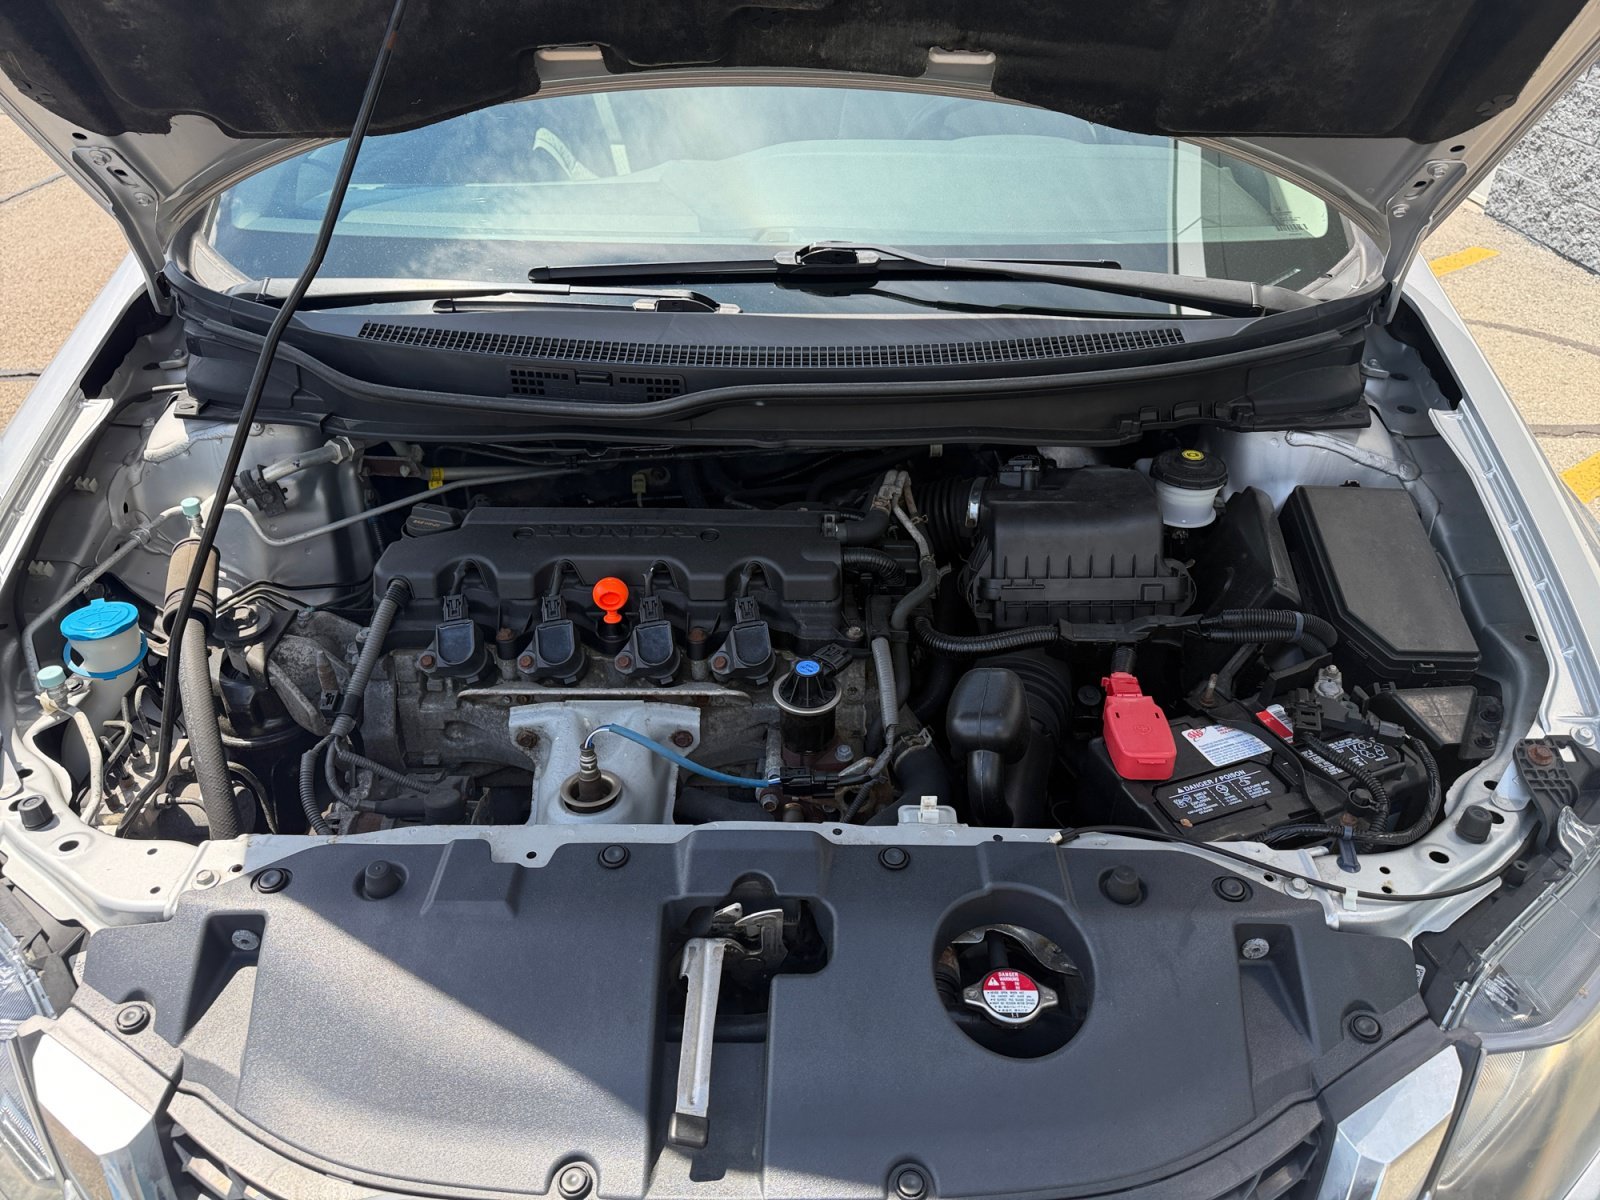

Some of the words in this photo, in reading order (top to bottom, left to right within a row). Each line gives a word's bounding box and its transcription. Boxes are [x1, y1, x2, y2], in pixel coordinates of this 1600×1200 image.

[535, 523, 697, 538] HONDA
[1183, 779, 1214, 792] DANGER
[1219, 769, 1247, 781] POISON
